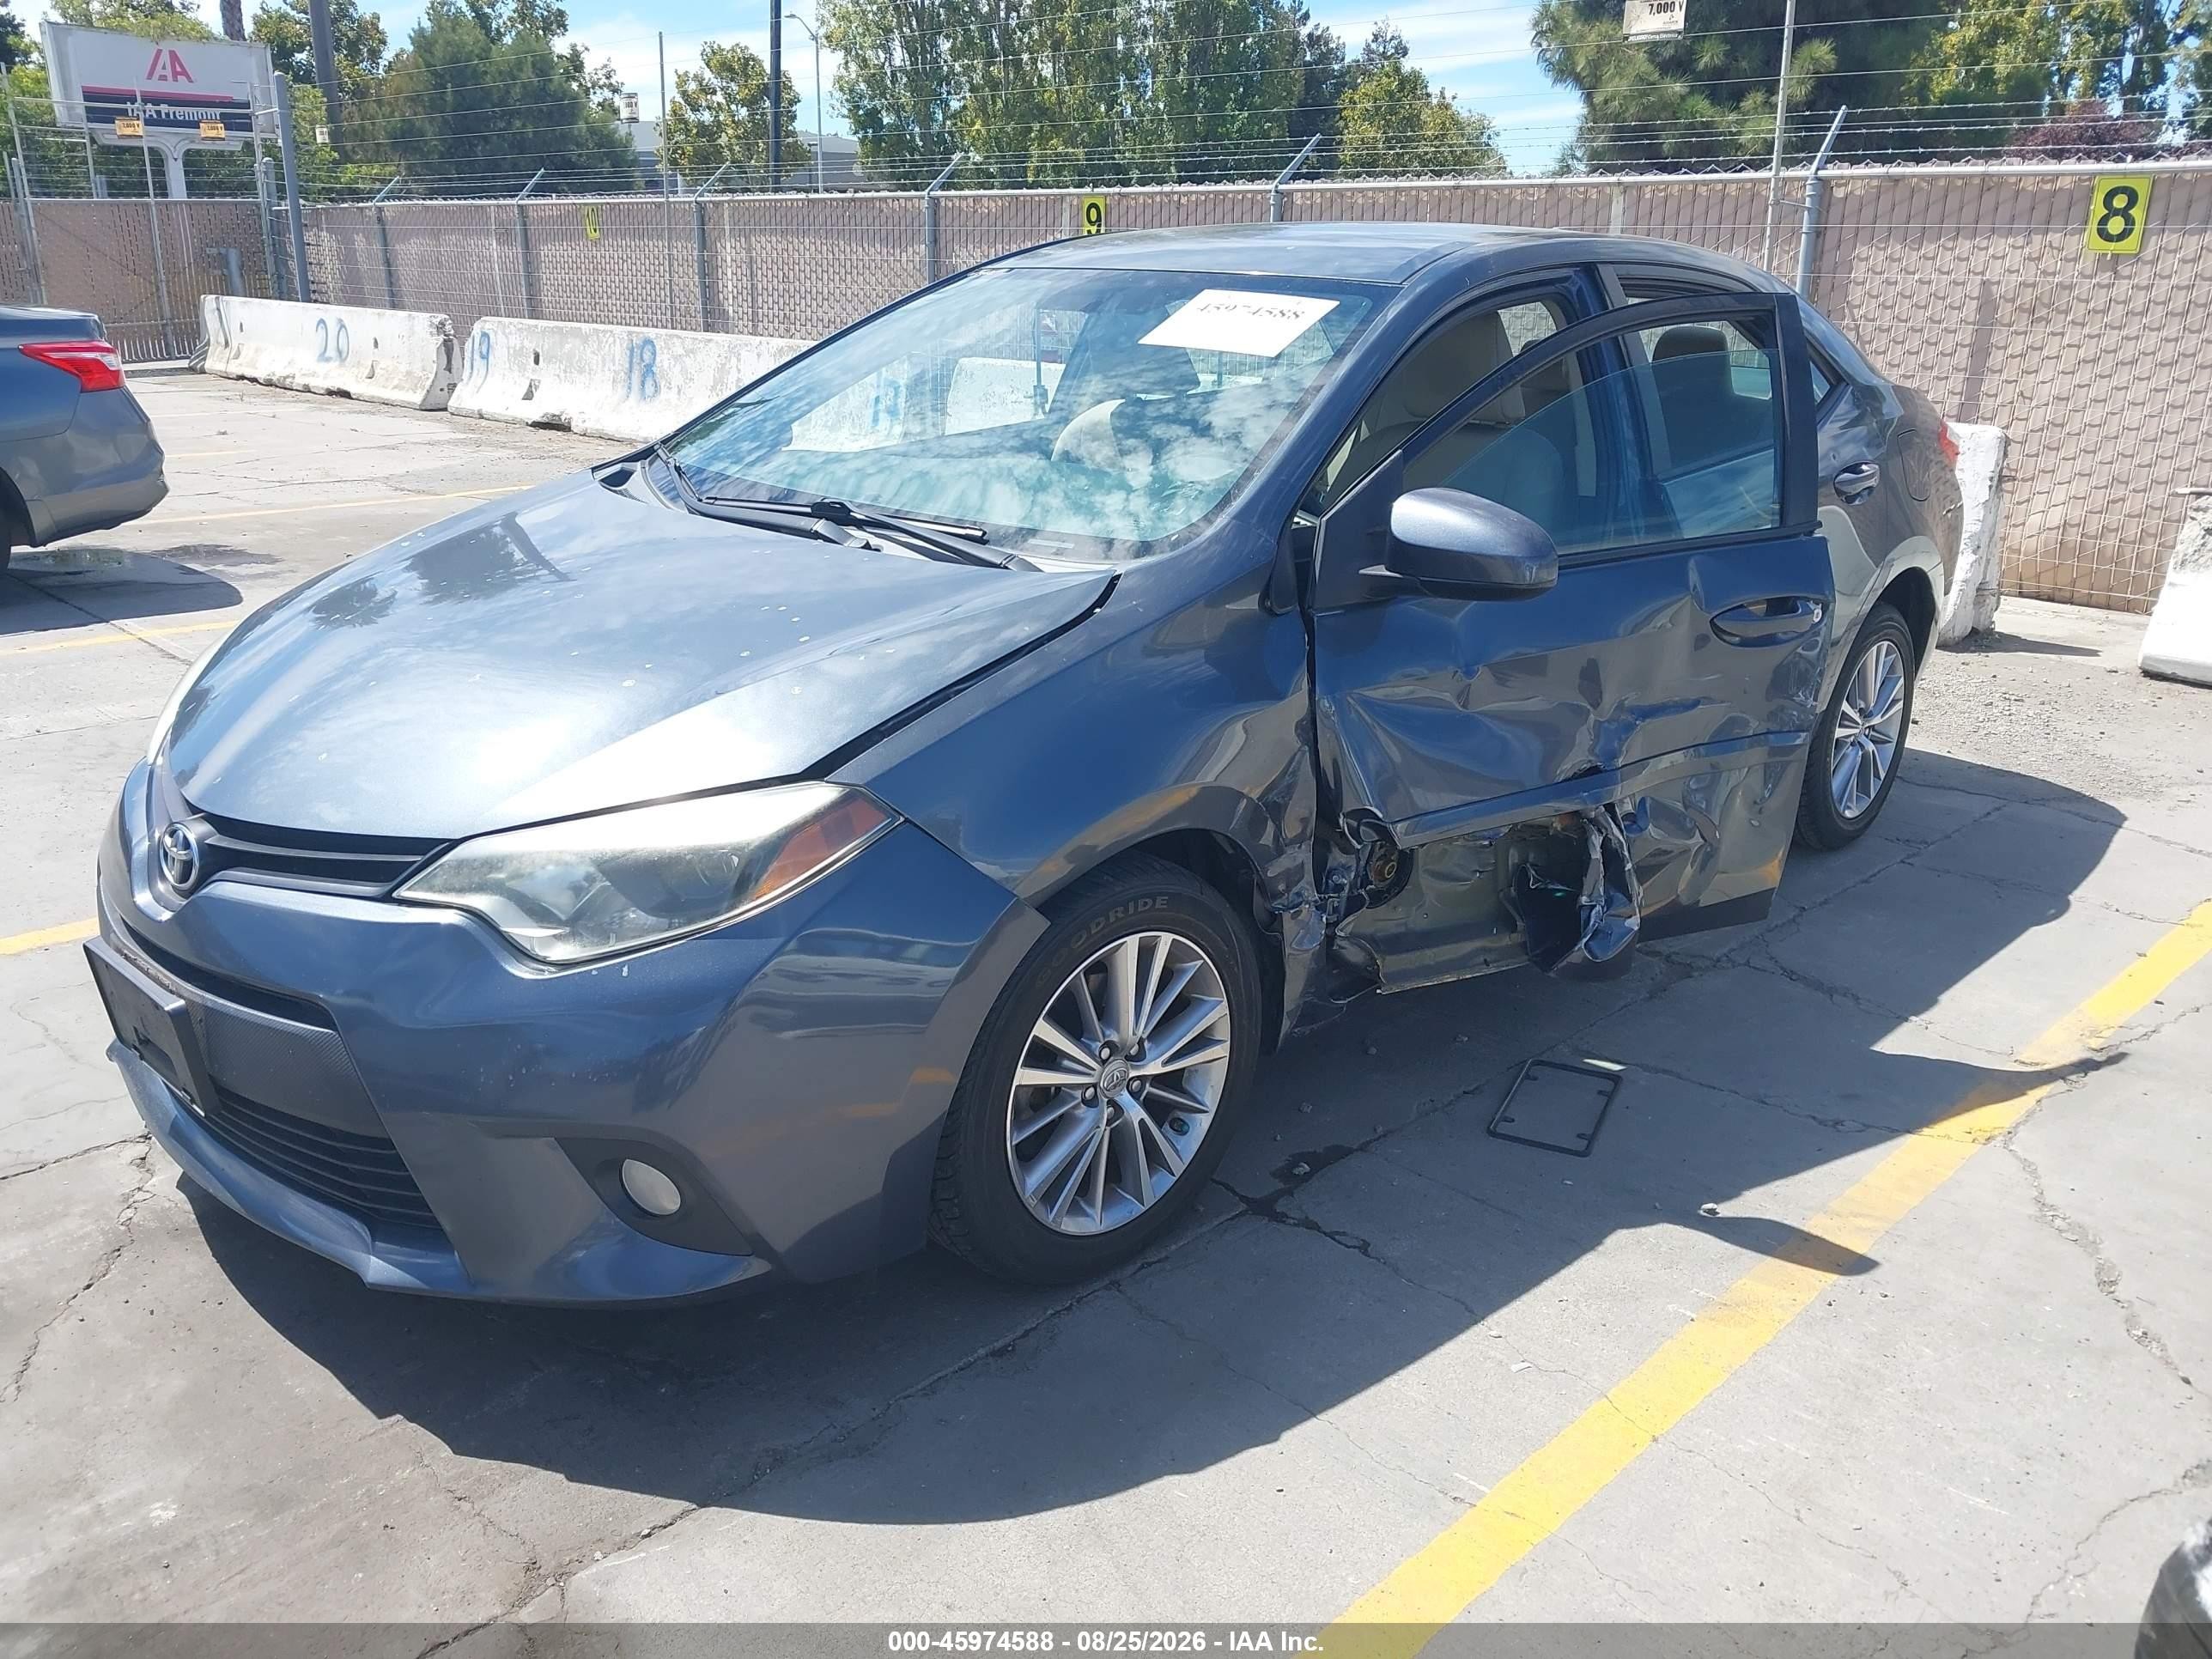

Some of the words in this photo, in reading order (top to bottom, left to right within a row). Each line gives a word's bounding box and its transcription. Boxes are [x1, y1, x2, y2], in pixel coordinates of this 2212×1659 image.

[1648, 1, 1676, 16] 7,000
[1678, 0, 1685, 12] V
[586, 207, 598, 234] 10
[1085, 202, 1103, 234] 9
[2096, 185, 2139, 243] 8
[315, 317, 350, 363] 20
[467, 331, 490, 393] 19
[626, 337, 660, 399] 18
